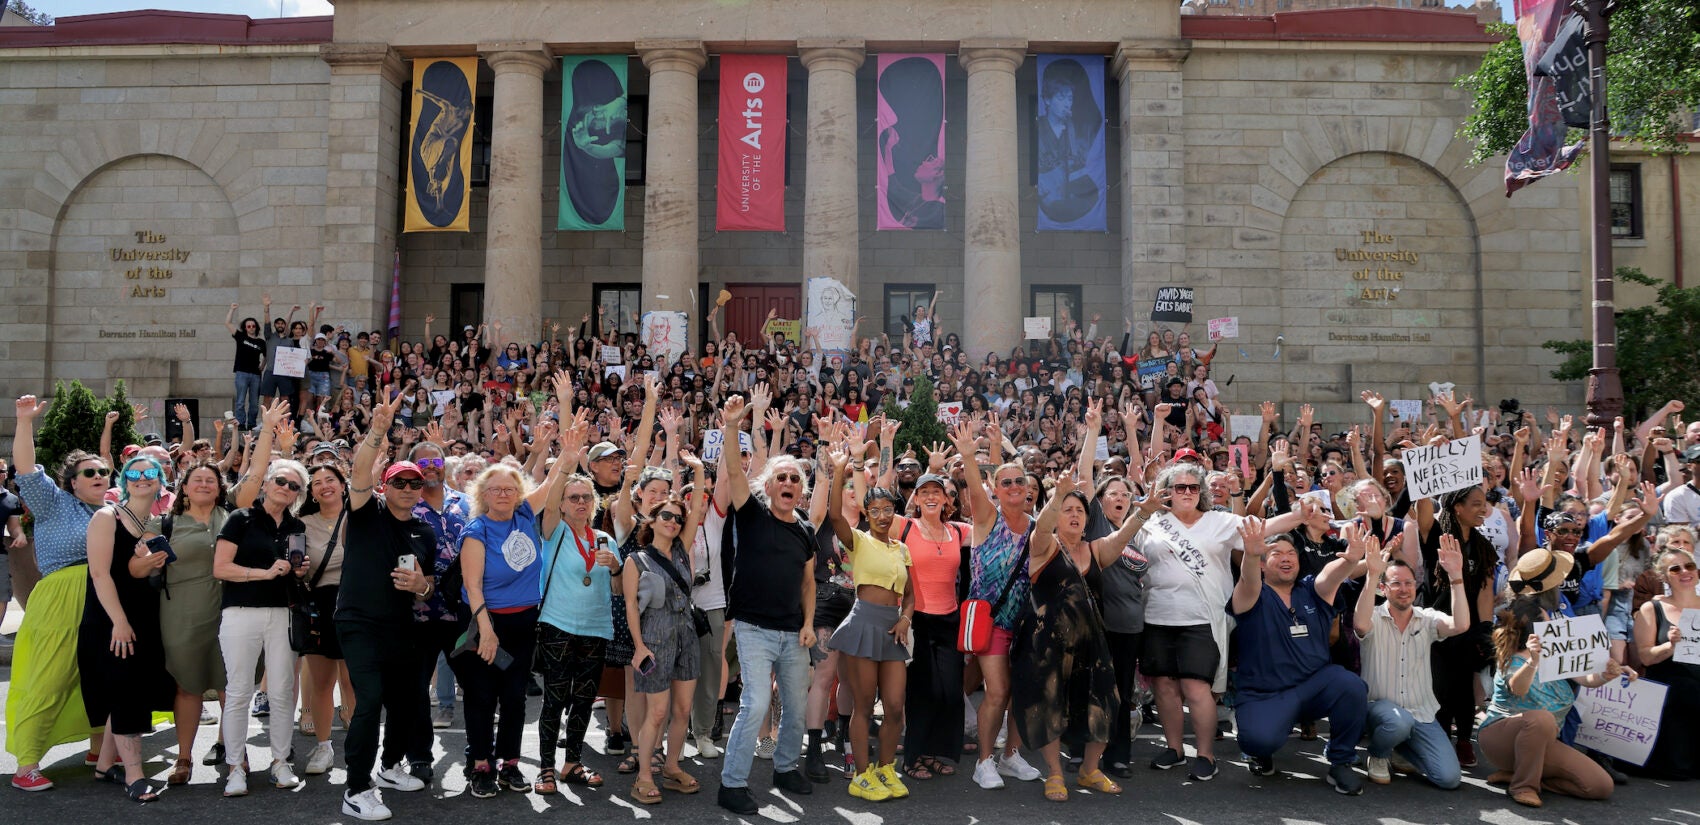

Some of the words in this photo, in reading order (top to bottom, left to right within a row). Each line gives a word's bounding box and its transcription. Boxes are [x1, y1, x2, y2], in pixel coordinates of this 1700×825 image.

[740, 97, 763, 150] Arts
[752, 154, 761, 174] THE
[741, 154, 750, 212] UNIVERSITY
[752, 178, 761, 191] OF
[135, 230, 167, 243] The
[1361, 230, 1394, 243] The
[110, 248, 190, 264] University
[1334, 248, 1419, 265] University
[125, 266, 142, 280] of
[147, 266, 173, 280] the
[1352, 267, 1370, 281] of
[1377, 267, 1404, 281] the
[131, 284, 166, 298] Arts
[1158, 288, 1179, 300] DAVID
[1361, 286, 1397, 301] Arts
[1155, 300, 1173, 312] EATS
[99, 330, 136, 339] Dorrance
[139, 329, 177, 338] Hamilton
[178, 329, 197, 338] Hall
[1328, 332, 1368, 341] Dorrance
[1370, 332, 1410, 342] Hamilton
[1412, 332, 1432, 342] Hall
[1406, 440, 1469, 466] PHILLY
[1413, 459, 1459, 484] NEEDS
[1542, 619, 1575, 638] Art
[1540, 638, 1588, 660] SAVED
[1590, 630, 1611, 651] MY
[1585, 684, 1638, 709] PHILLY
[1591, 702, 1658, 731] DESERVES
[1594, 718, 1654, 744] BETTER!
